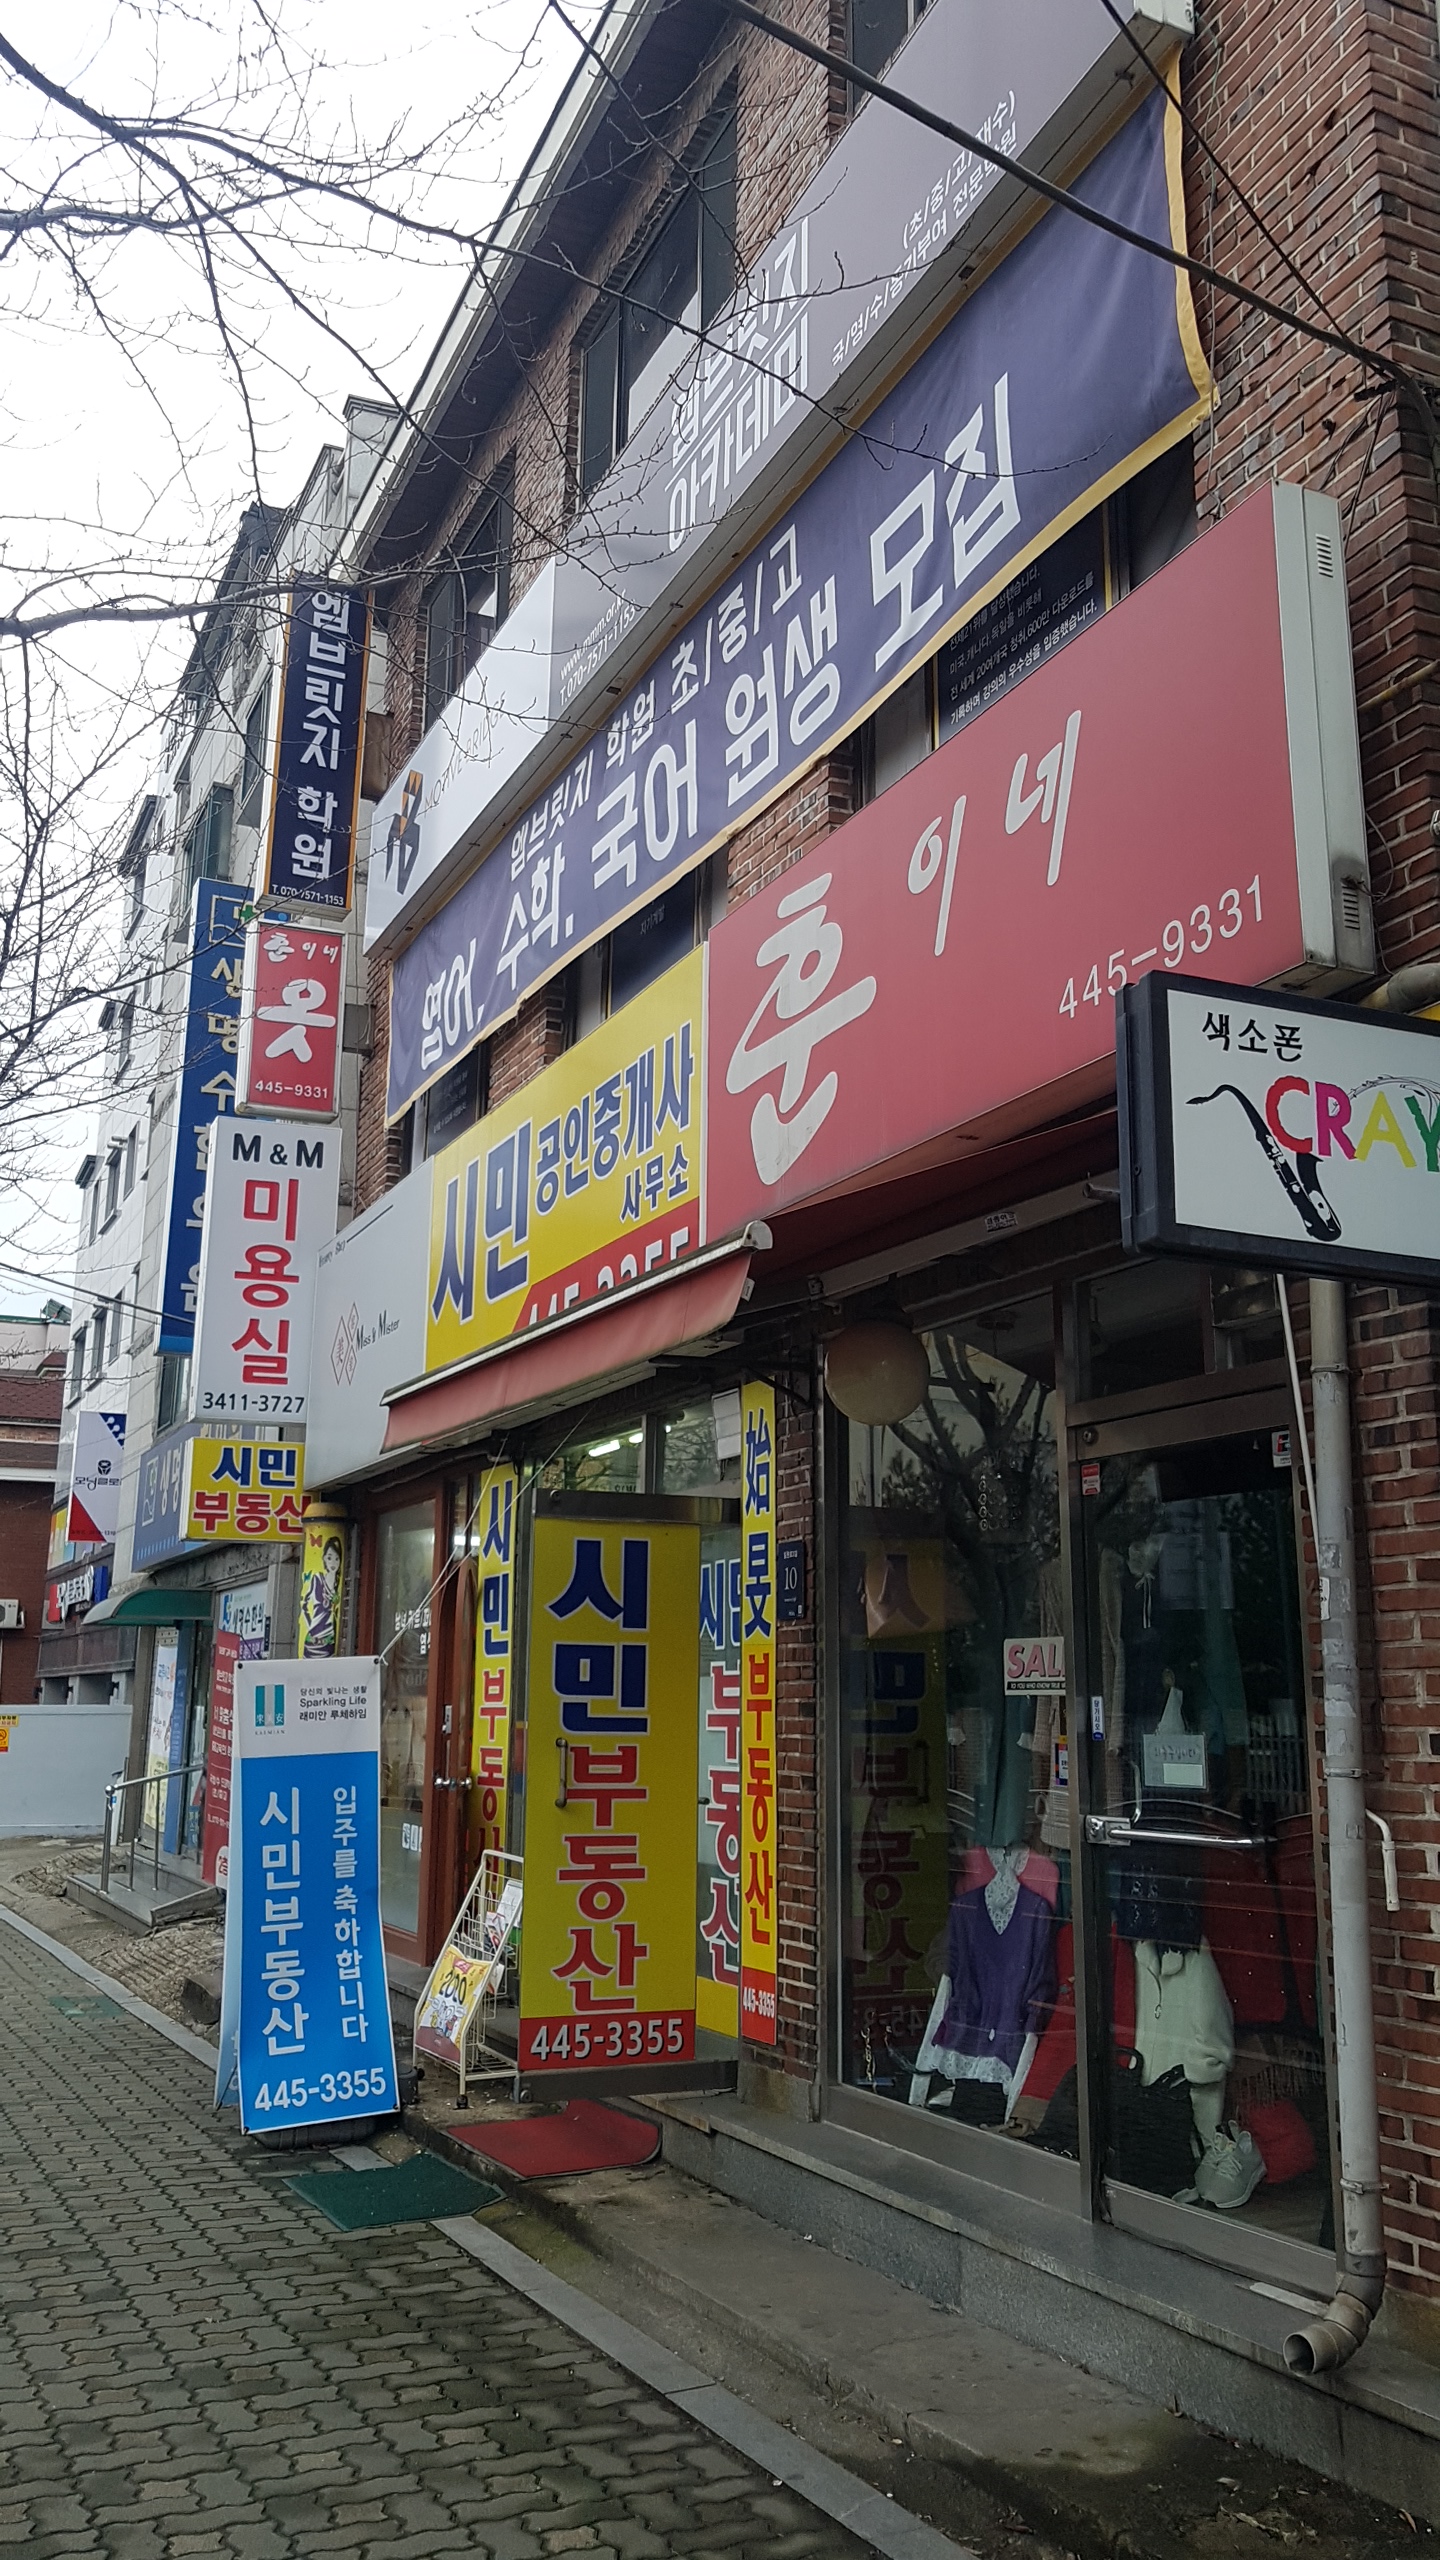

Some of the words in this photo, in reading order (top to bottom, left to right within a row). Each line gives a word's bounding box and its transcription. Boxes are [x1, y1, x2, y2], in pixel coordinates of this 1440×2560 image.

[670, 312, 808, 551] 아카데미
[591, 718, 698, 889] 국어
[725, 574, 841, 807] 원생
[870, 371, 1021, 672] 모집
[960, 670, 975, 692] 세계
[1052, 571, 1094, 616] 다운로드를
[950, 692, 980, 725] 기록하며
[983, 670, 1007, 700] 강의의
[1008, 642, 1041, 679] 우수성을
[1043, 598, 1097, 652] 입증했습니다.
[511, 749, 593, 881] 엠브릿지
[606, 680, 655, 769] 학원
[671, 524, 802, 715] 초/중/고
[290, 785, 338, 879] 학원
[1058, 873, 1264, 1018] 445-9331
[1202, 1011, 1303, 1062] 색소폰
[255, 1080, 328, 1099] 445-9331
[431, 1117, 532, 1325] 시민
[536, 1019, 695, 1217] 공인중개사
[619, 1142, 690, 1224] 사무소
[231, 1178, 300, 1385] 미용실
[356, 1324, 371, 1352] Miss
[378, 1310, 400, 1338] Mister
[203, 1393, 305, 1414] 3411-3727
[212, 1447, 297, 1488] 시민
[785, 1567, 797, 1590] 10
[1007, 1644, 1065, 1678] SAL
[300, 1687, 323, 1696] 당신의
[327, 1686, 349, 1695] 빛나는
[300, 1697, 346, 1708] Sparkling
[349, 1696, 367, 1705] Life
[300, 1710, 327, 1721] 래미안
[330, 1708, 367, 1720] 루체하임
[743, 1986, 775, 2018] 445-3355
[531, 2018, 684, 2060] 445-3355
[255, 2067, 387, 2111] 445-3355
